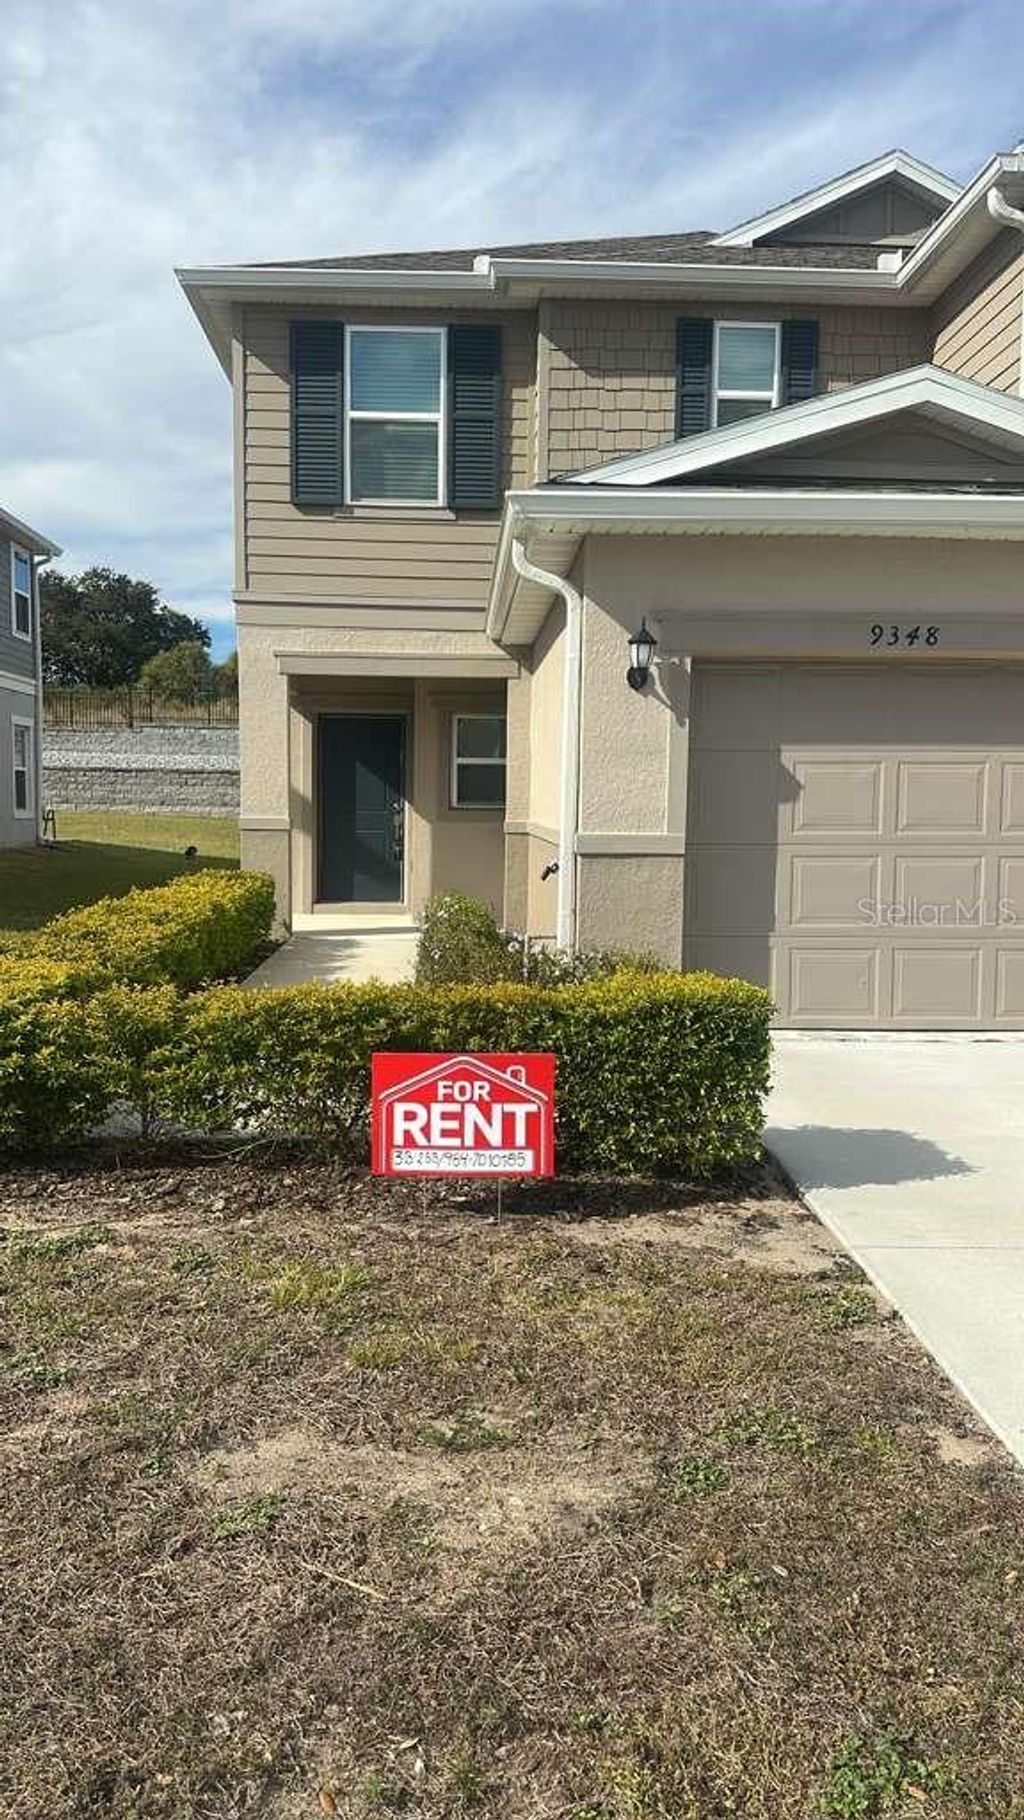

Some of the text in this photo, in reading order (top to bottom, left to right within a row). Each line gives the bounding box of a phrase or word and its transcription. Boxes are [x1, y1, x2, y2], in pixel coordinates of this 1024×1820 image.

[870, 624, 940, 646] 9348
[437, 1081, 491, 1101] FOR
[393, 1103, 538, 1147] RENT
